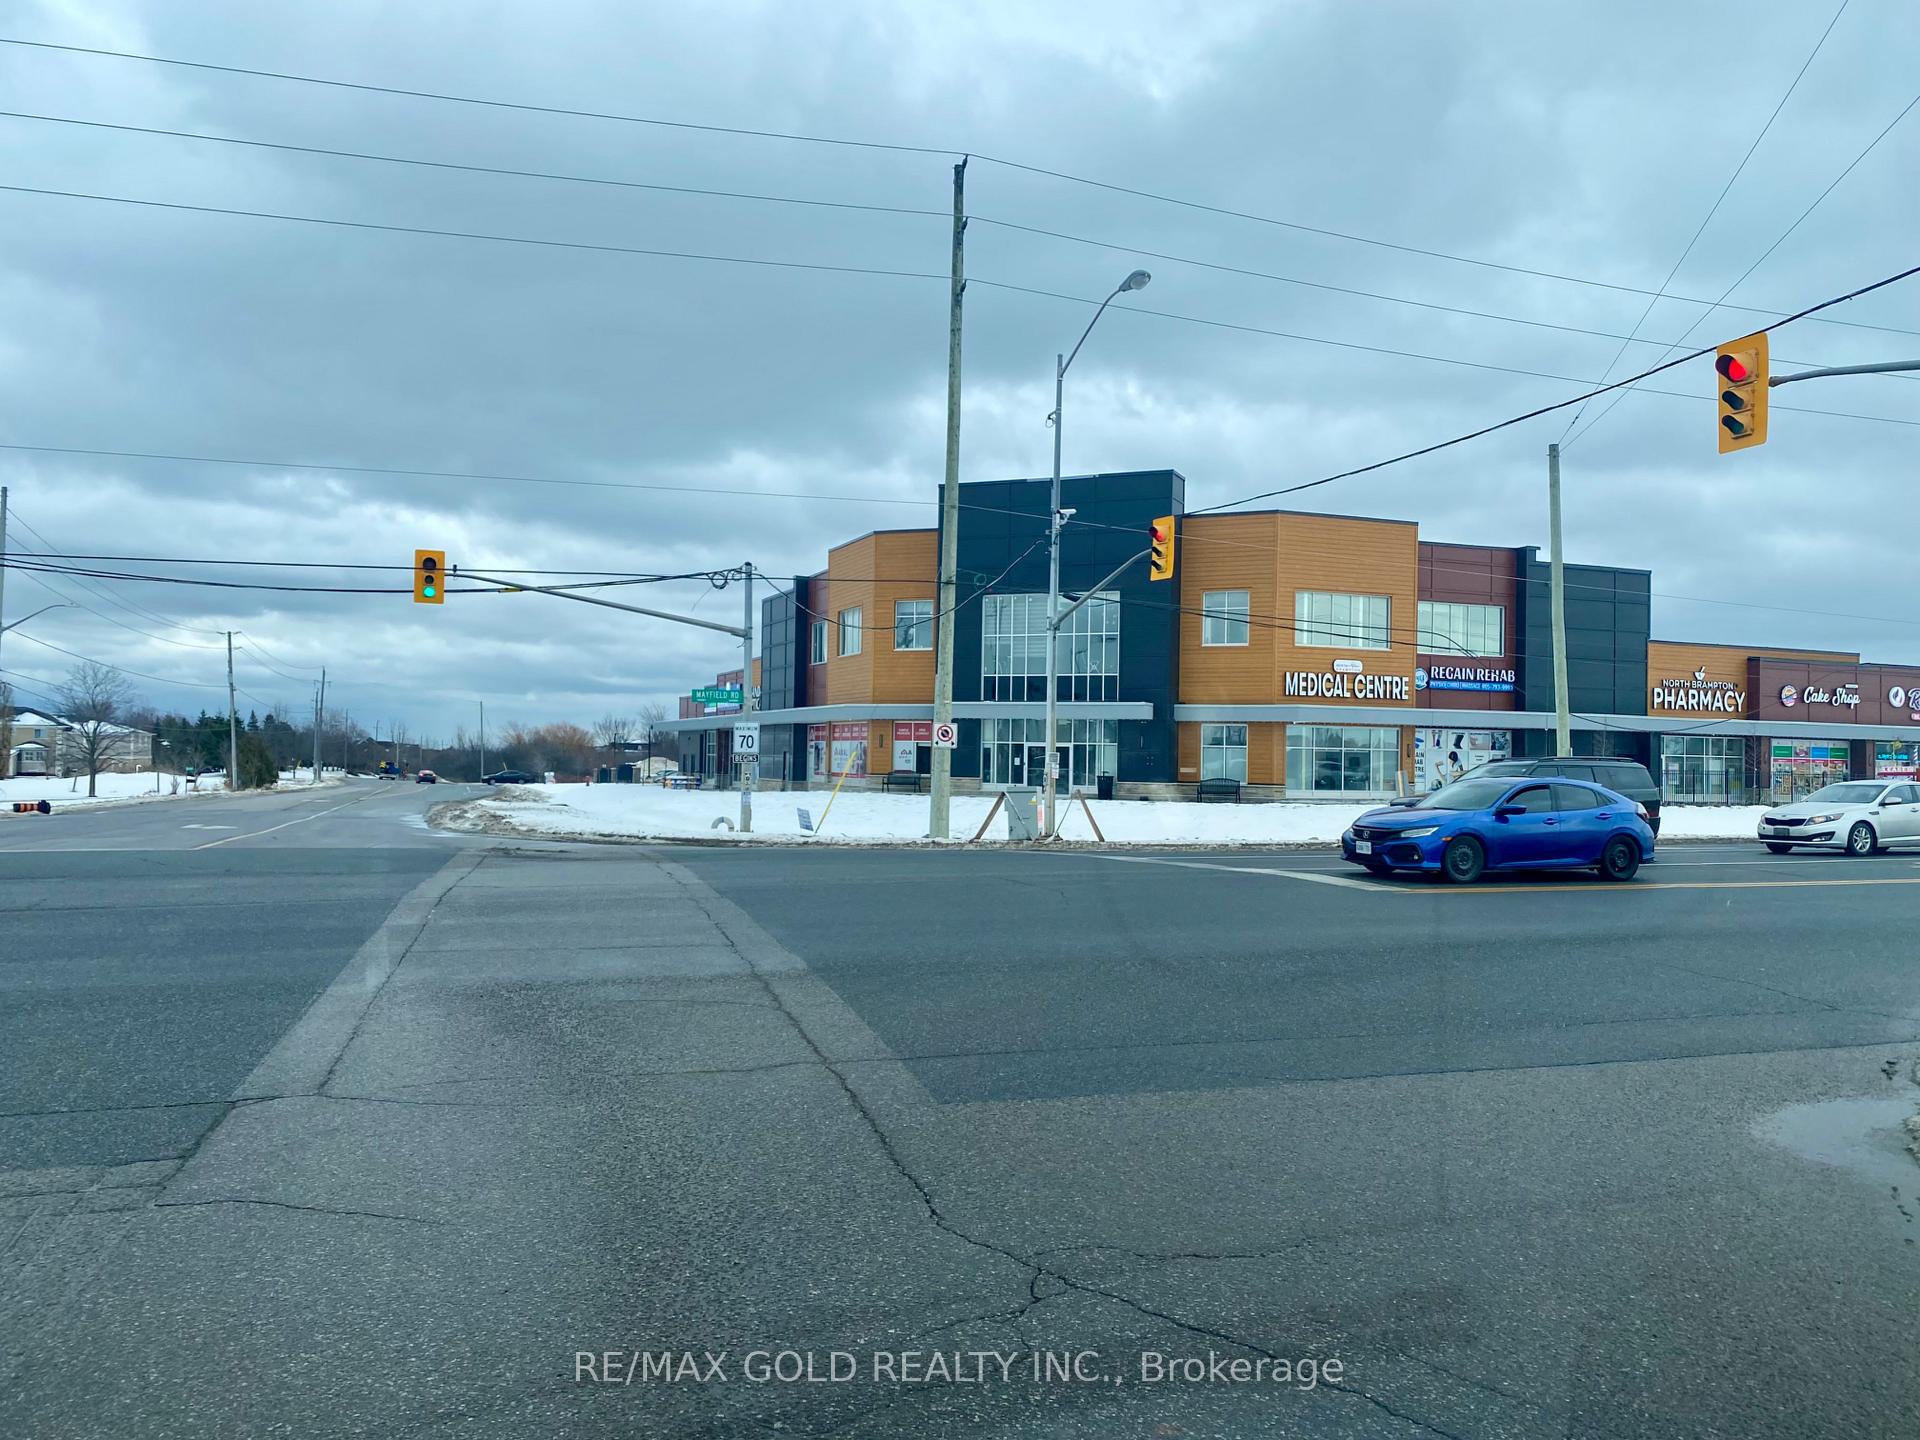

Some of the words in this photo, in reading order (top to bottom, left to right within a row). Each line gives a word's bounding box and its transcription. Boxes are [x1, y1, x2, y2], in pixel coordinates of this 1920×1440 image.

[1431, 666, 1474, 680] REGAIN
[1476, 668, 1515, 682] REHAB
[1285, 671, 1351, 698] MEDICAL
[1354, 674, 1409, 700] CENTRE
[1663, 679, 1690, 689] NORTH
[1691, 680, 1734, 690] BRAMPTON
[696, 690, 728, 700] MAYFIELD
[730, 691, 740, 700] RD
[1653, 688, 1746, 712] PHARMACY
[1803, 686, 1830, 704] Cake
[1832, 687, 1861, 710] Shop
[738, 734, 755, 749] 70
